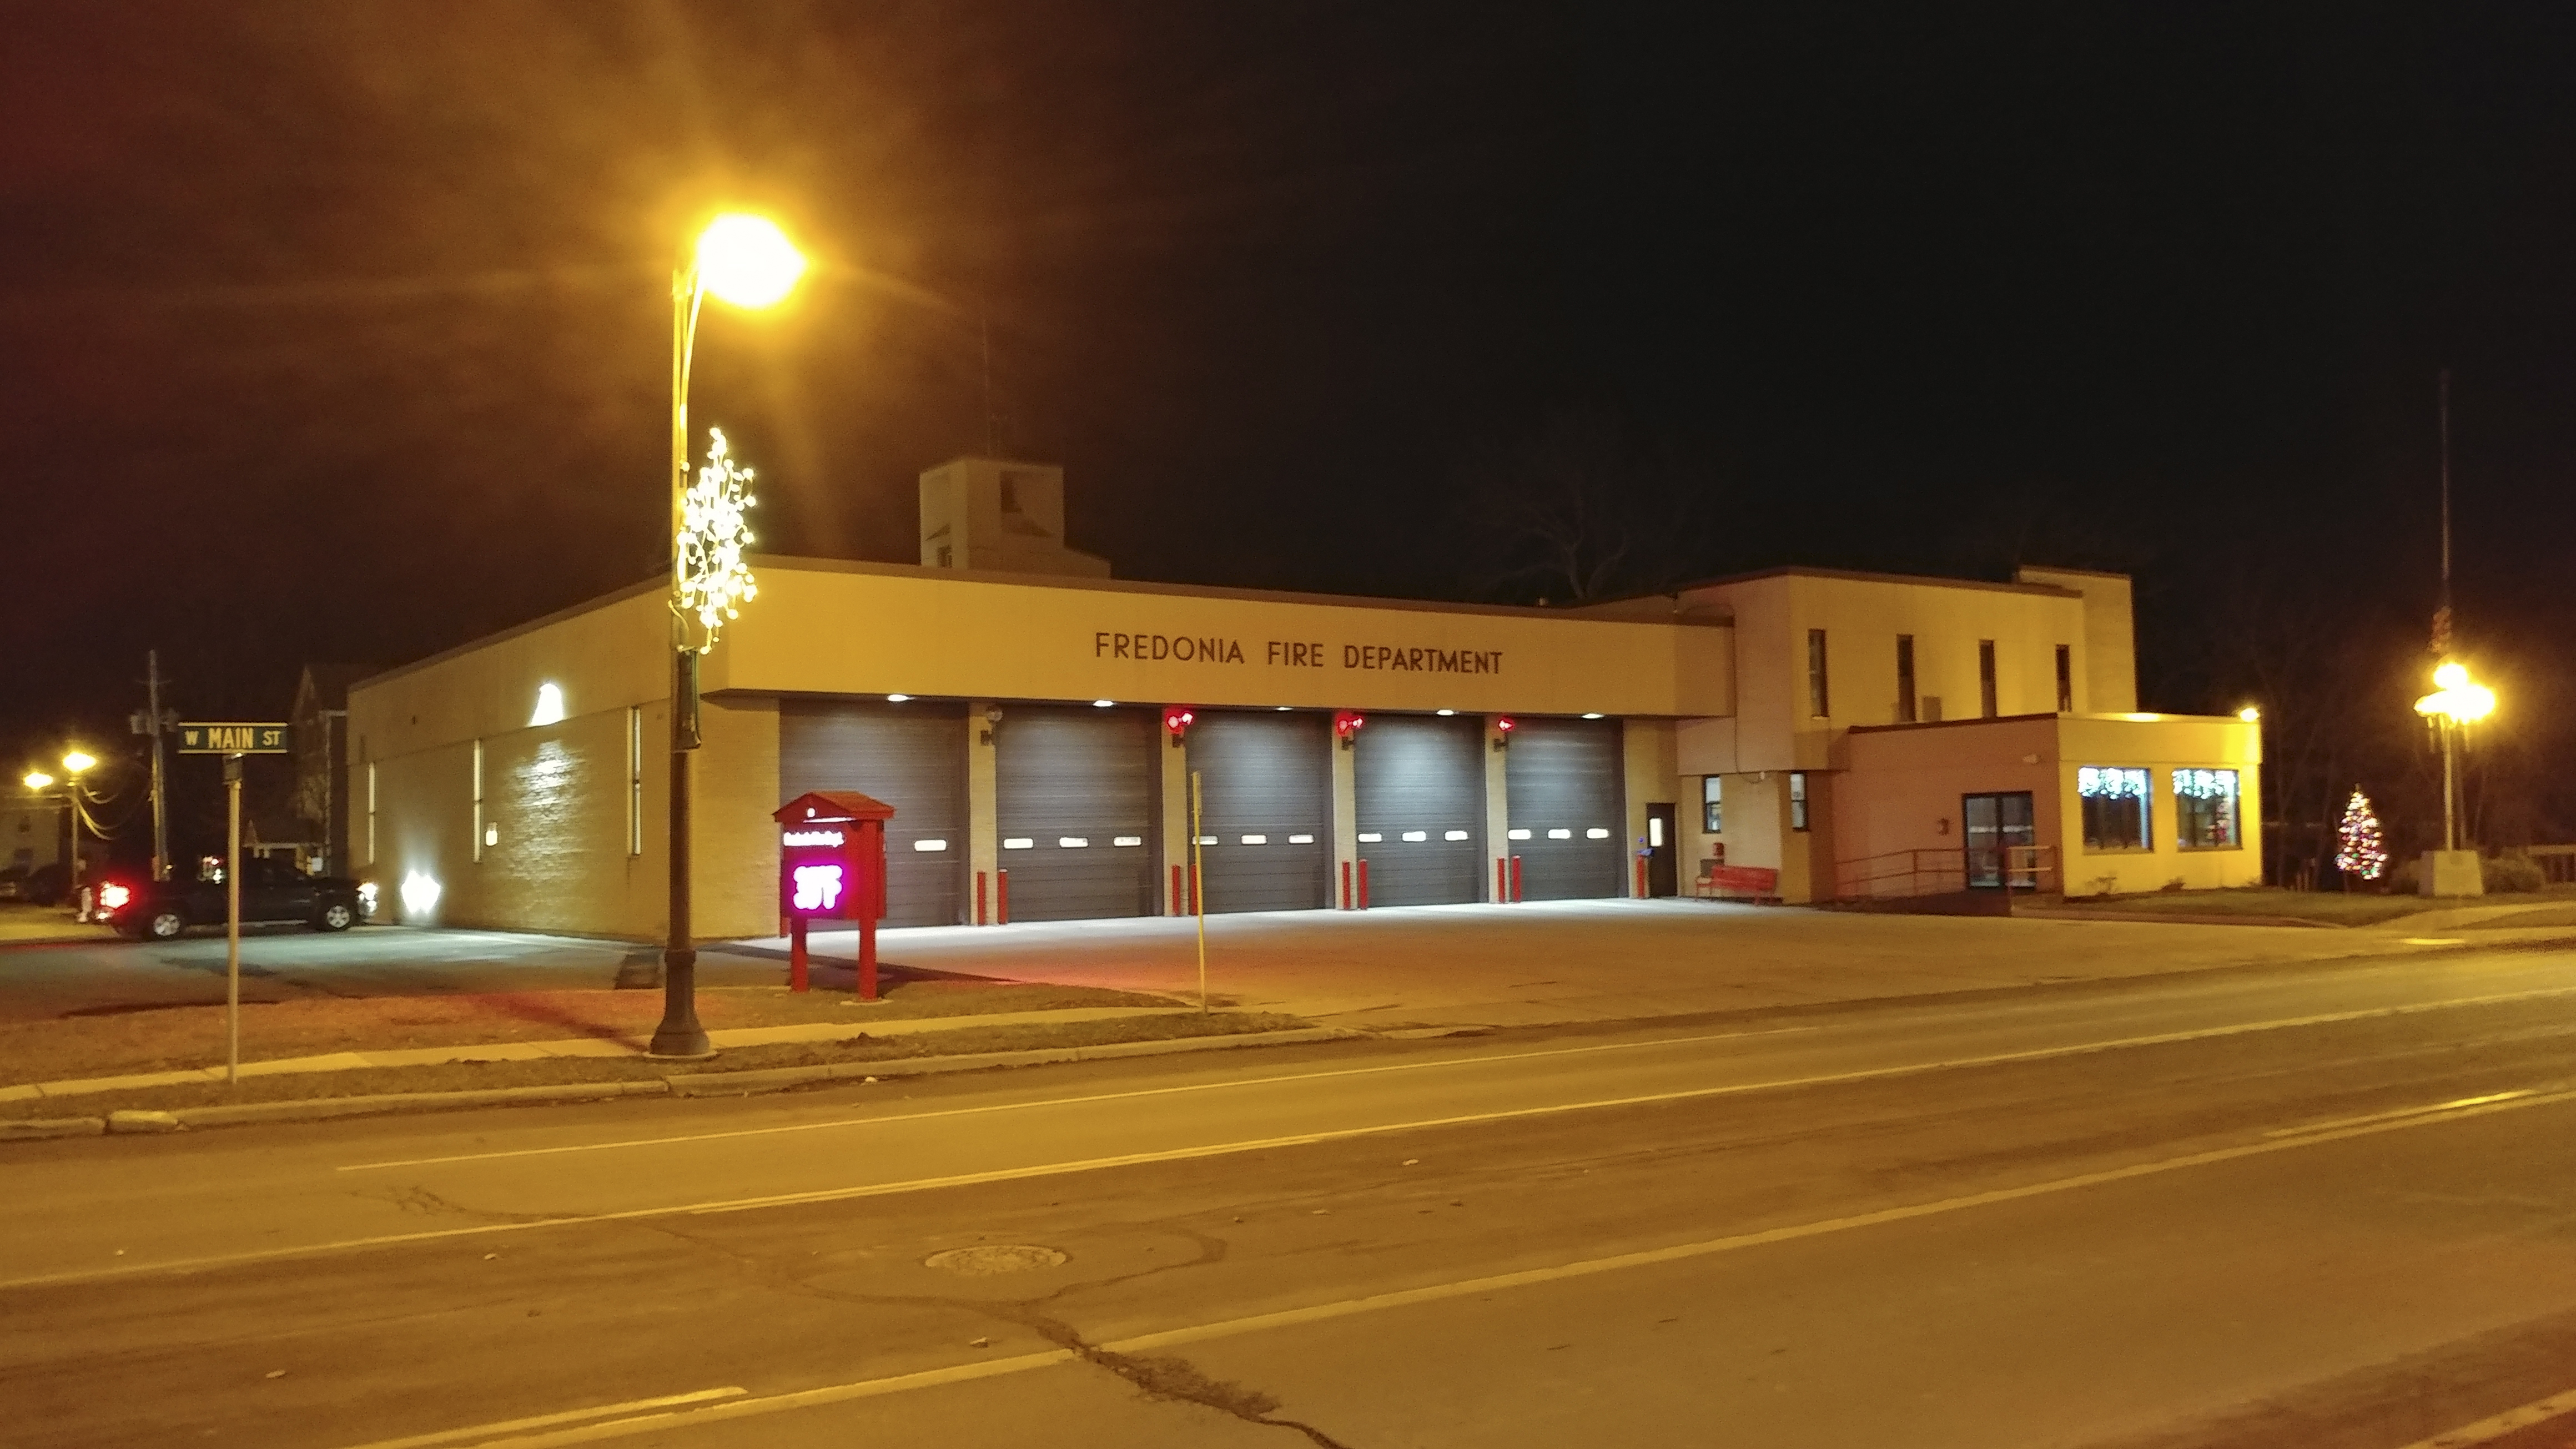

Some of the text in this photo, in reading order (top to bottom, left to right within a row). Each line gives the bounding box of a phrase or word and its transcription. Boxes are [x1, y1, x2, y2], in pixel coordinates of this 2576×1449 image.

[1095, 632, 1503, 674] FREDONIA FIRE DEPARTMENT
[185, 727, 281, 748] W MAIN ST
